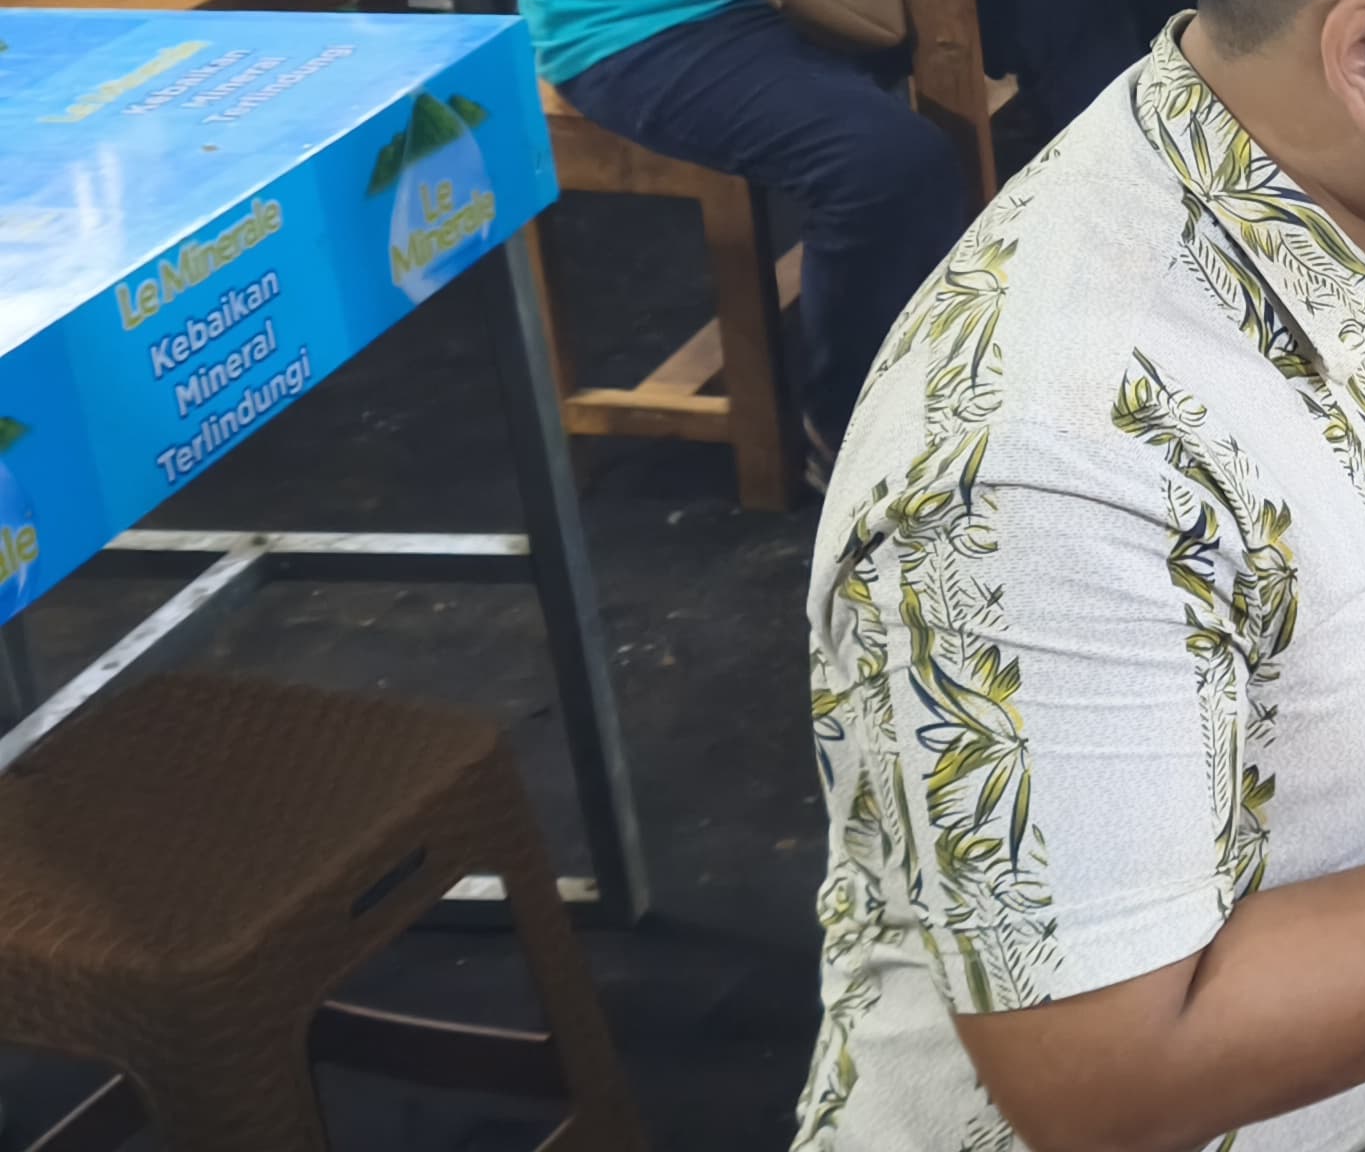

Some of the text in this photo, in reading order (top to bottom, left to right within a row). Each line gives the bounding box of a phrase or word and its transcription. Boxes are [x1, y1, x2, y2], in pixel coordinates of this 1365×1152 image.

[122, 48, 252, 116] Kebaikan
[183, 56, 287, 110] Mineral
[203, 43, 357, 125] Terlindungi
[388, 190, 495, 284] Minerale
[419, 179, 453, 221] Le
[117, 197, 283, 331] Le Minerale
[150, 268, 279, 379] Kebaikan
[175, 320, 276, 418] Mineral
[157, 348, 311, 484] Terlindungi
